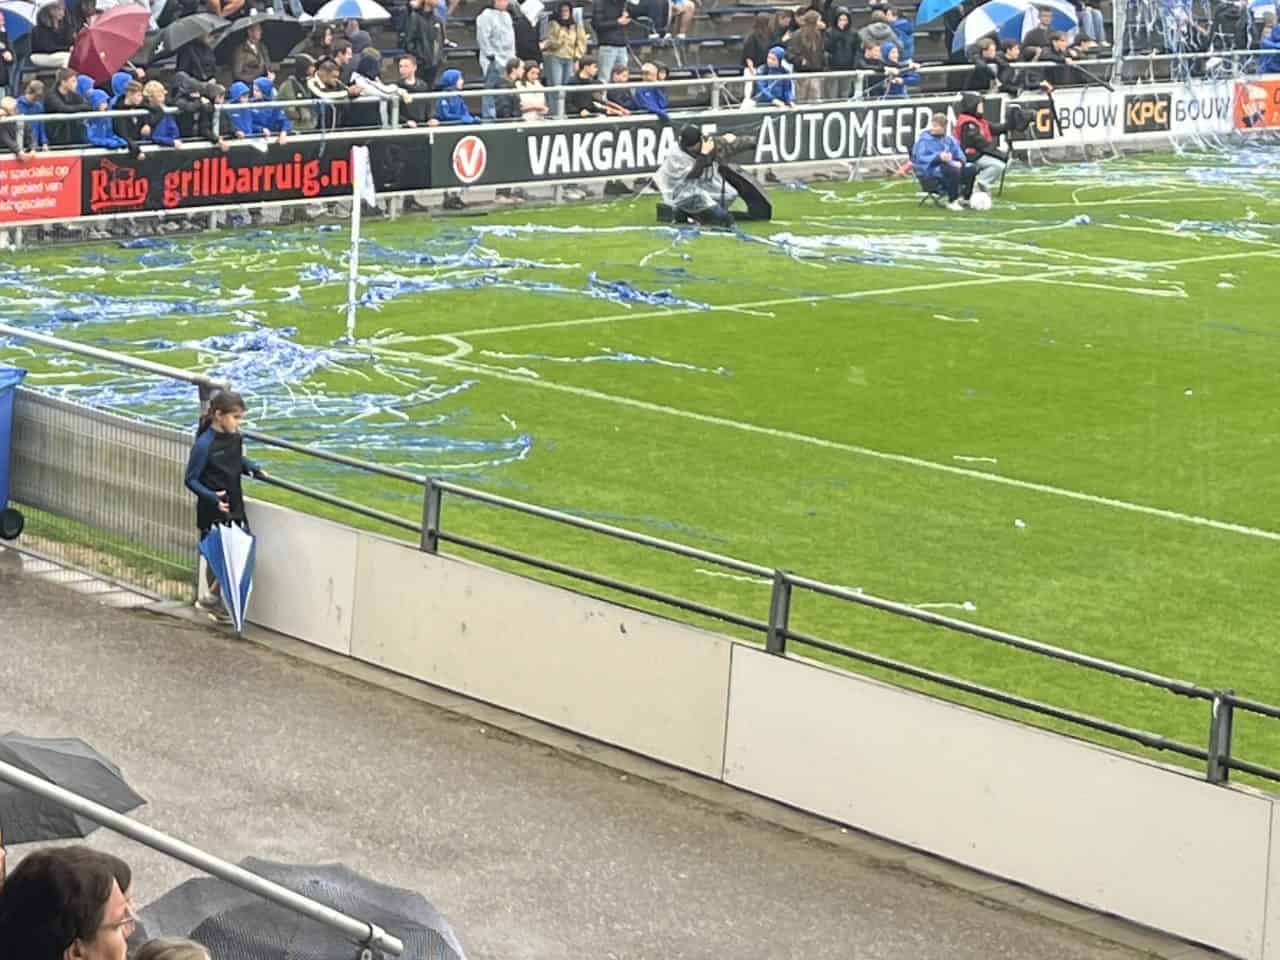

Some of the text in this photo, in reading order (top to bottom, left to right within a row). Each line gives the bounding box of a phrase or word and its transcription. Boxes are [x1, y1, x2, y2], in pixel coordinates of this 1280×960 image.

[1059, 103, 1118, 130] BOUW
[1126, 101, 1169, 126] KPG
[1175, 96, 1231, 122] BOUW
[527, 123, 718, 175] VAKGARA
